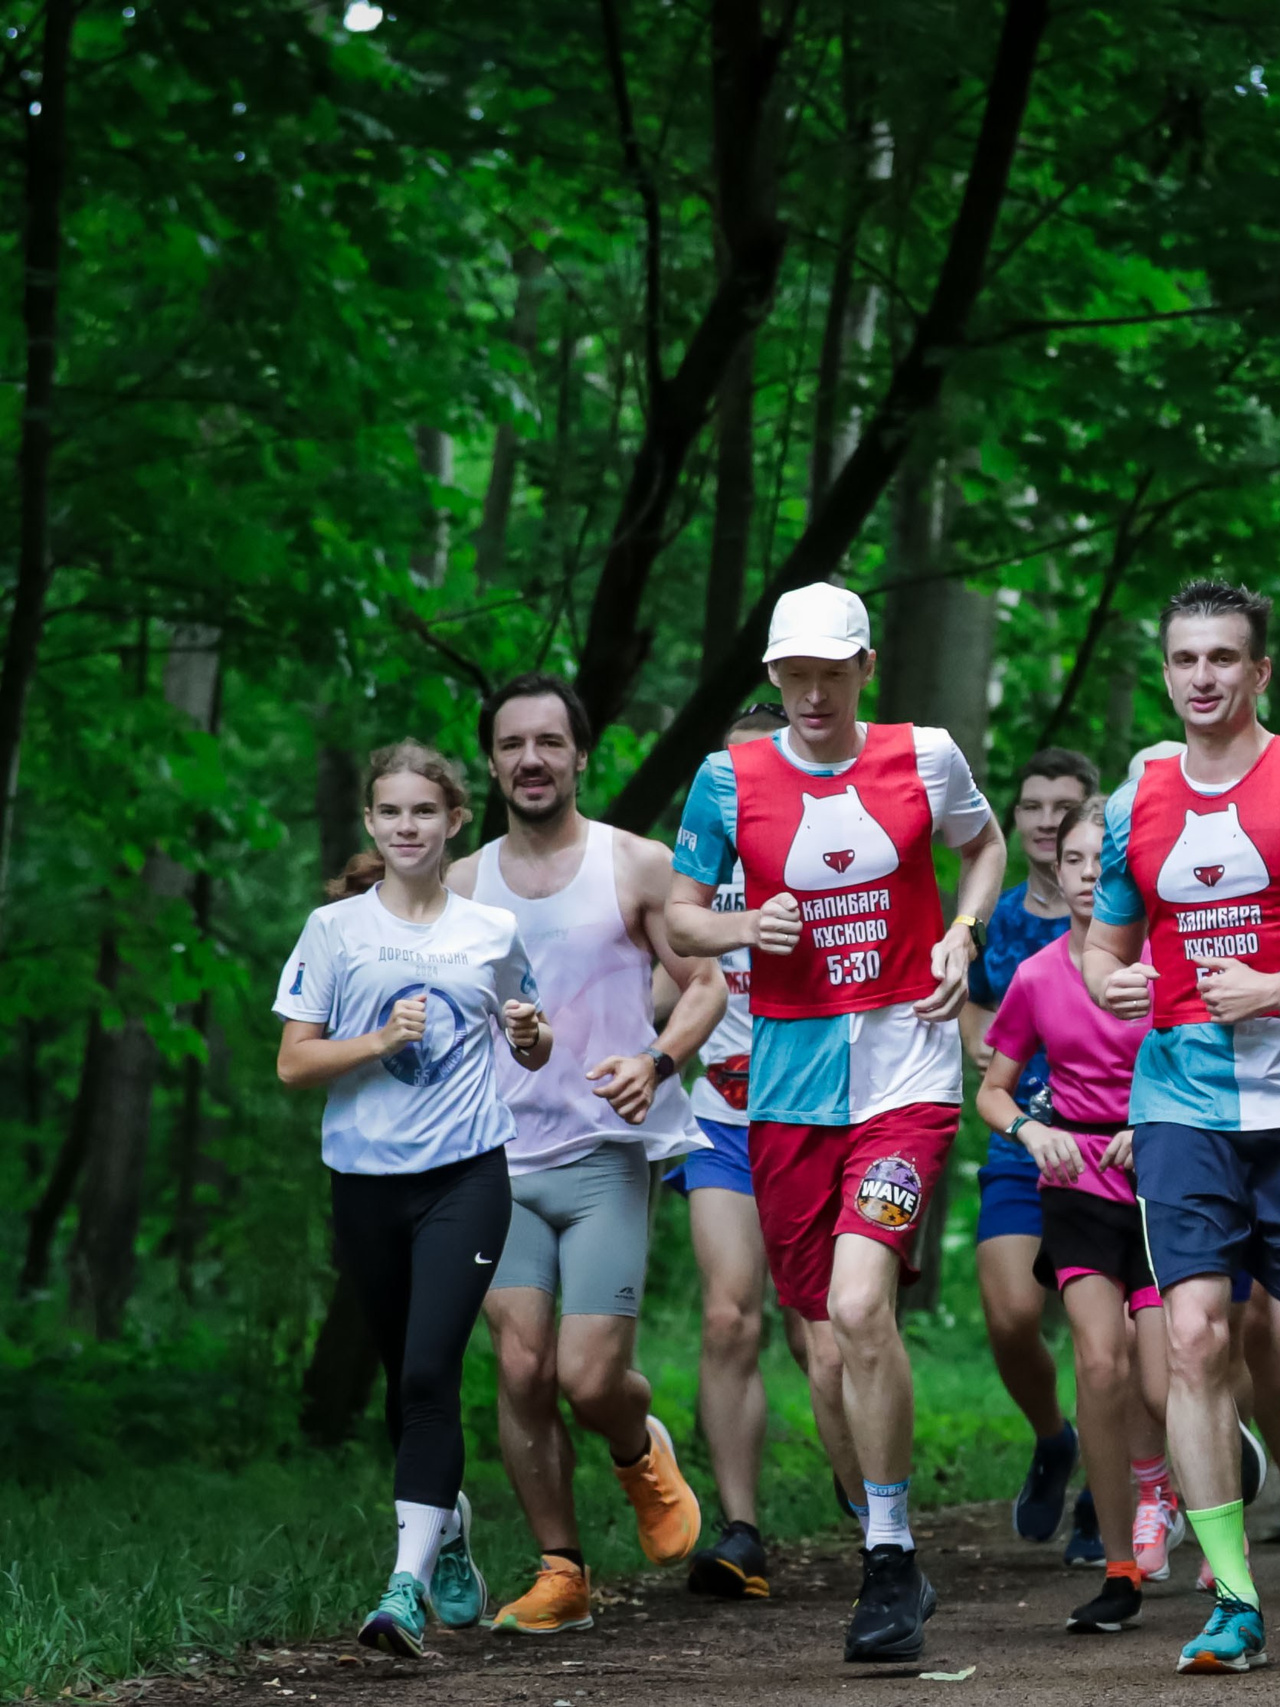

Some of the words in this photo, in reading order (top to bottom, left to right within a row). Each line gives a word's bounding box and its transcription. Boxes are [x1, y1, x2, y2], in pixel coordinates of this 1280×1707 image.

[802, 889, 890, 922] КАПИБАРА
[1176, 904, 1262, 933] КАПИБАРА
[812, 918, 888, 949] КУСКОВО
[1184, 932, 1259, 960] КУСКОВО
[378, 946, 424, 963] ДОРОГА
[428, 951, 469, 966] ЖИЗНИ
[415, 964, 439, 978] 2024
[826, 950, 881, 986] 5:30
[861, 1180, 917, 1213] WAVE
